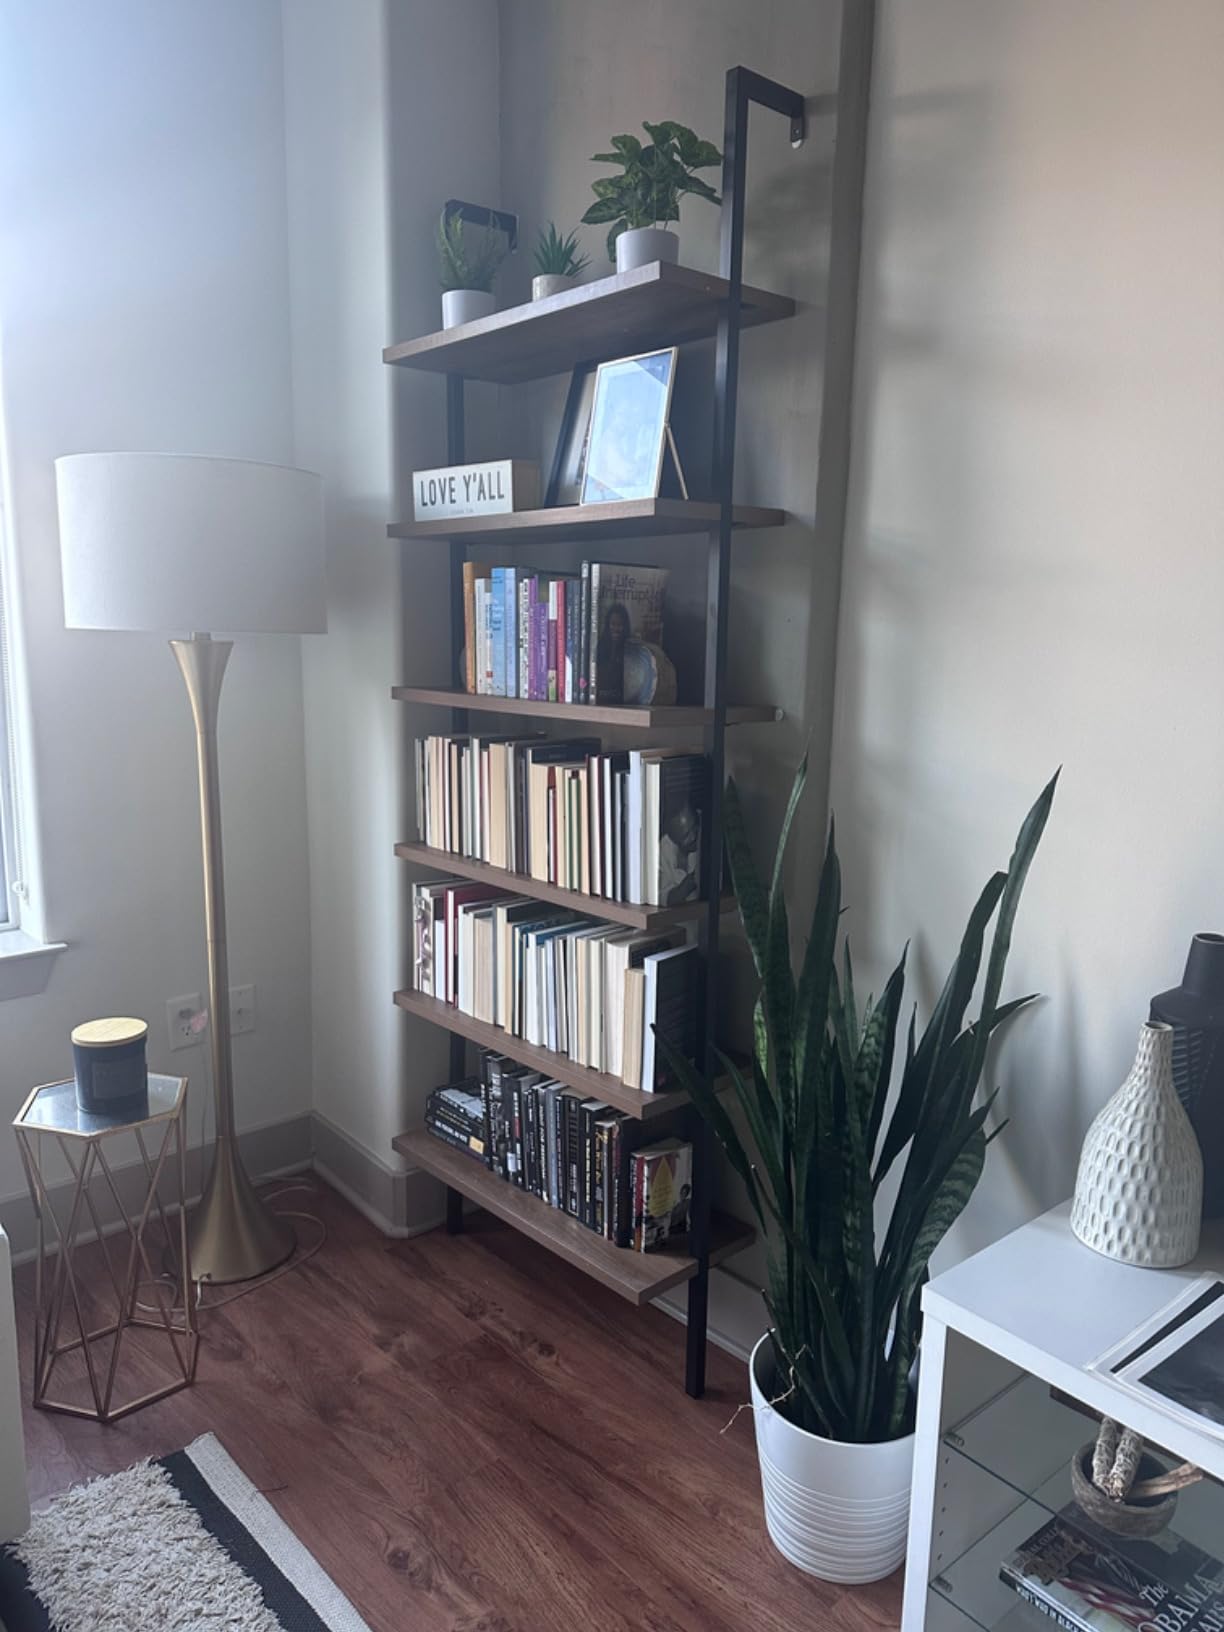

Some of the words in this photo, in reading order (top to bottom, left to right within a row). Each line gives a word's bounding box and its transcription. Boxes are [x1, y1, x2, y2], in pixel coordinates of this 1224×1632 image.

[420, 476, 456, 507] LOVE
[463, 470, 504, 503] Y'ALL
[1138, 1573, 1223, 1632] OBAMA
[1139, 1583, 1169, 1606] The
